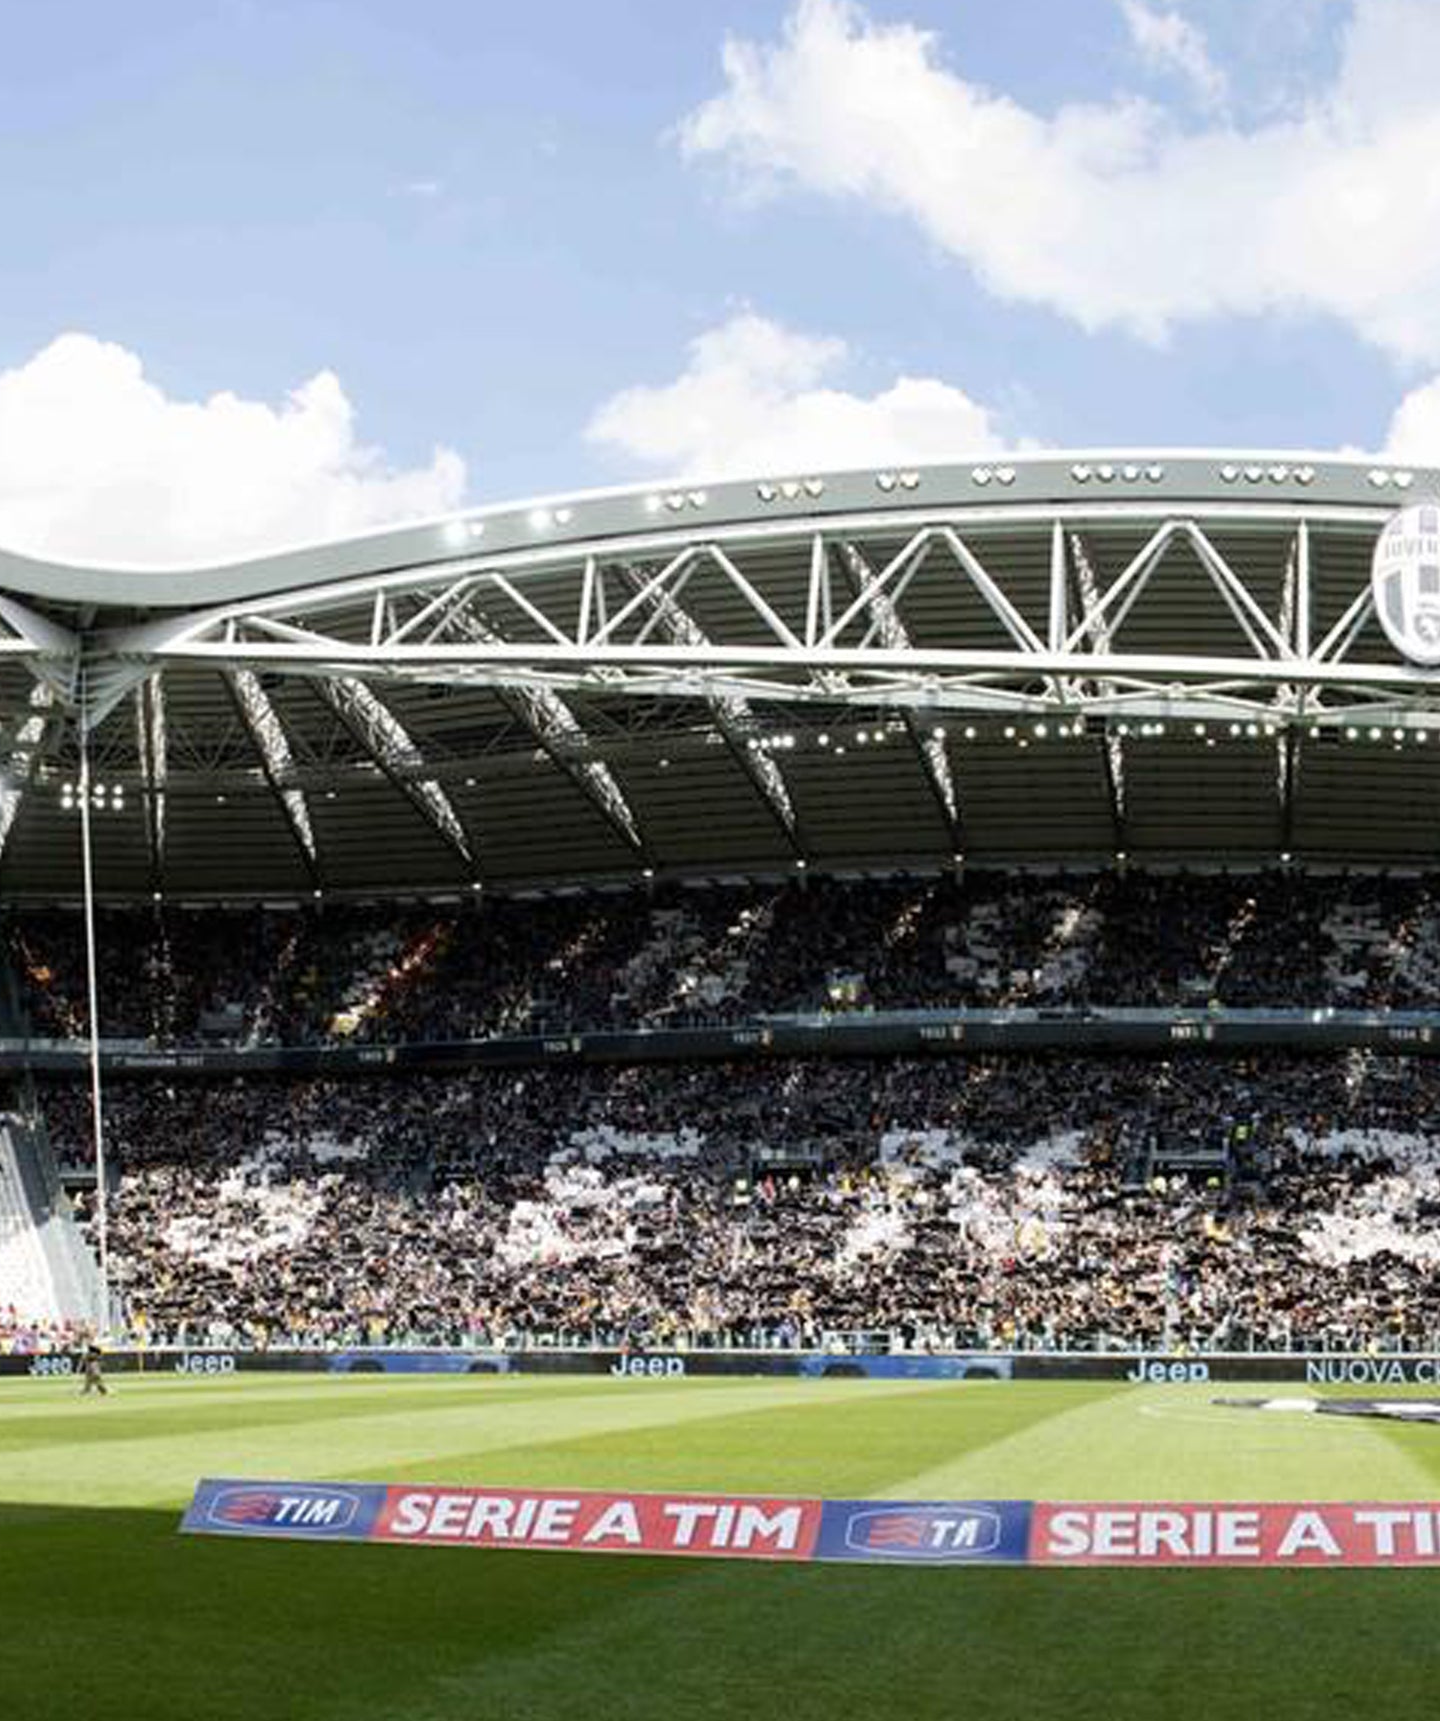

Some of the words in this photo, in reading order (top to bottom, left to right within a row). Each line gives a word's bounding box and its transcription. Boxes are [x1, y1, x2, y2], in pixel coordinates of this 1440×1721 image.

[176, 1354, 237, 1374] Jeep
[610, 1353, 686, 1379] Jeep
[1127, 1359, 1210, 1382] Jeep
[1306, 1360, 1404, 1384] NUOVA
[274, 1498, 342, 1525] TIM
[391, 1493, 581, 1541] SERIE
[582, 1500, 642, 1544] A
[664, 1502, 802, 1549] TIM
[1047, 1510, 1260, 1556] SERIE
[1276, 1511, 1343, 1557] A
